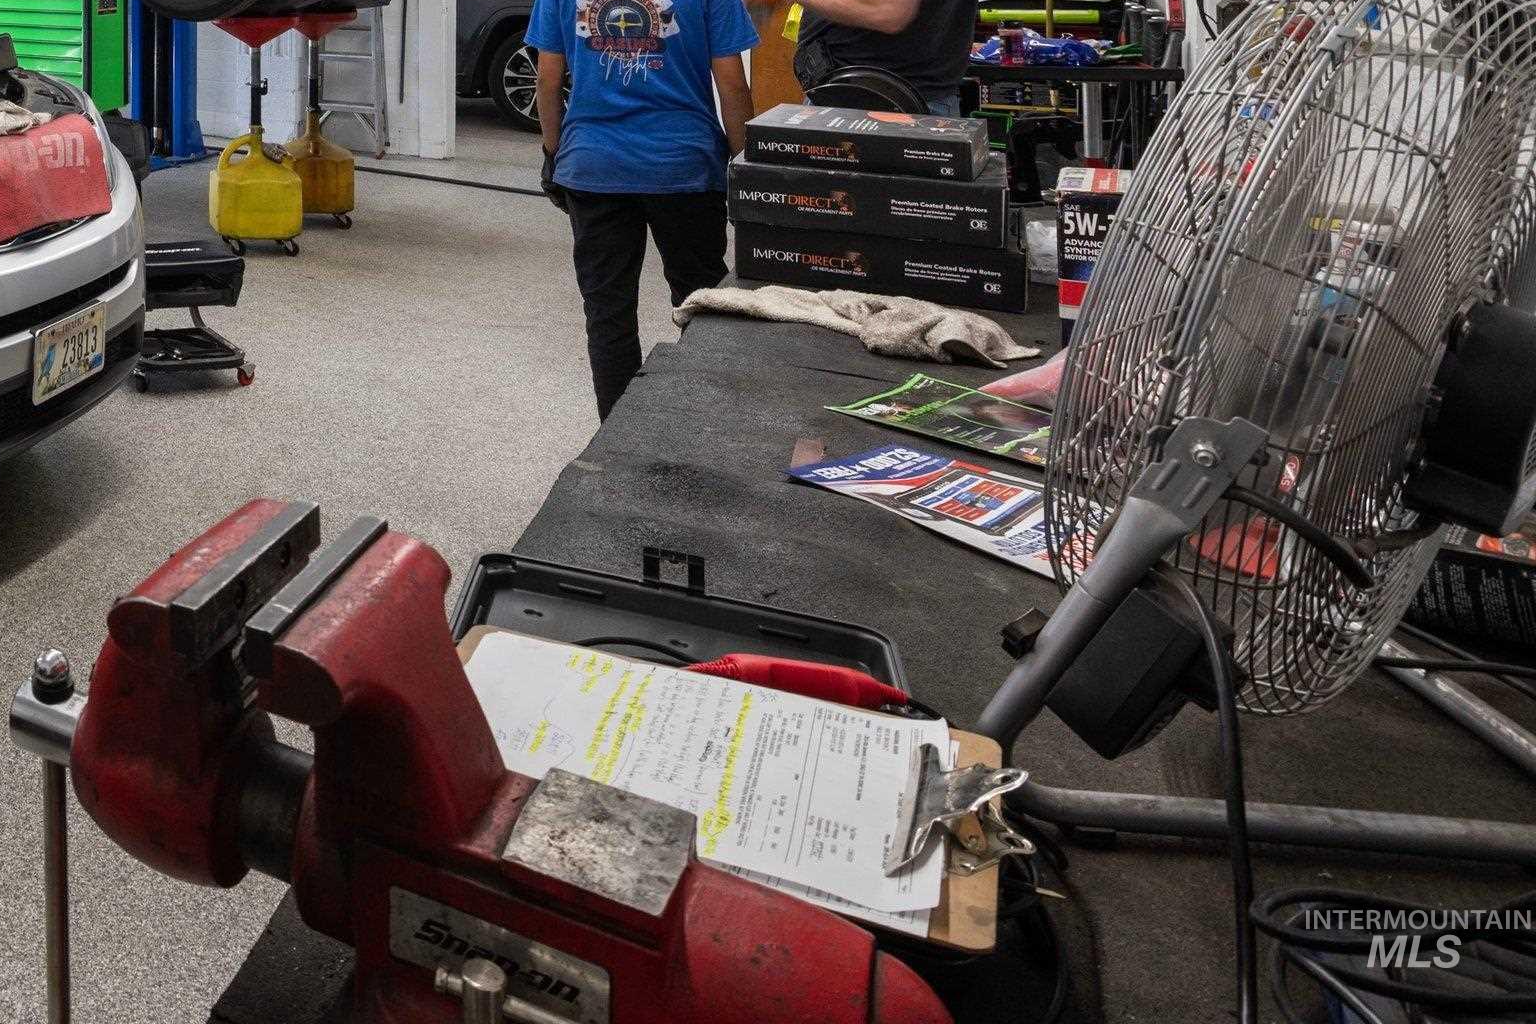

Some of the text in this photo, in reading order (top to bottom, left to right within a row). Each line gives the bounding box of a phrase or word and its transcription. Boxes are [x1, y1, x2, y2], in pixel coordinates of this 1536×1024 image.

[891, 199, 919, 207] Premium
[1064, 204, 1081, 212] SAE
[1064, 238, 1104, 248] ADVANC
[1064, 246, 1102, 256] SYNTHE
[905, 260, 933, 269] Premium
[934, 264, 957, 272] Coated
[979, 269, 1001, 277] Rotors
